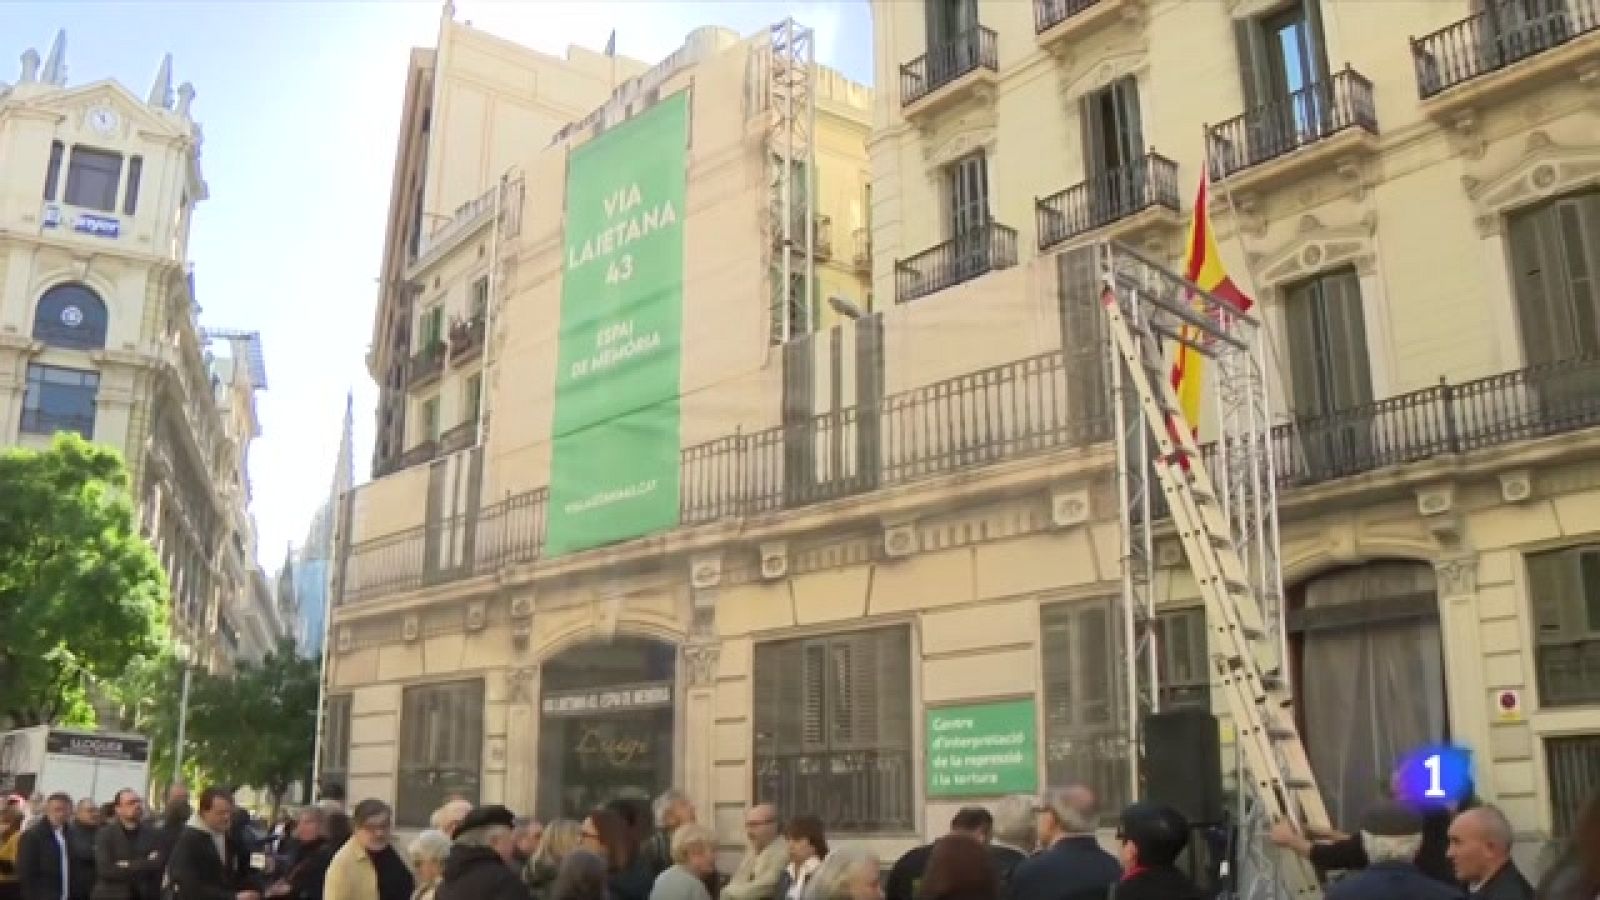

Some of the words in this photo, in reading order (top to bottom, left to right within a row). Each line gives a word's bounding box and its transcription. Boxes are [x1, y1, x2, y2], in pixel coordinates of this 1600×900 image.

[603, 183, 641, 217] VIA
[568, 201, 677, 270] LAIETANA
[605, 254, 634, 284] 43
[597, 320, 633, 348] ESPAI
[572, 358, 589, 378] DE
[932, 717, 974, 731] Centre
[932, 754, 948, 768] de
[950, 754, 962, 767] la
[939, 774, 951, 786] la
[954, 773, 999, 786] tortura
